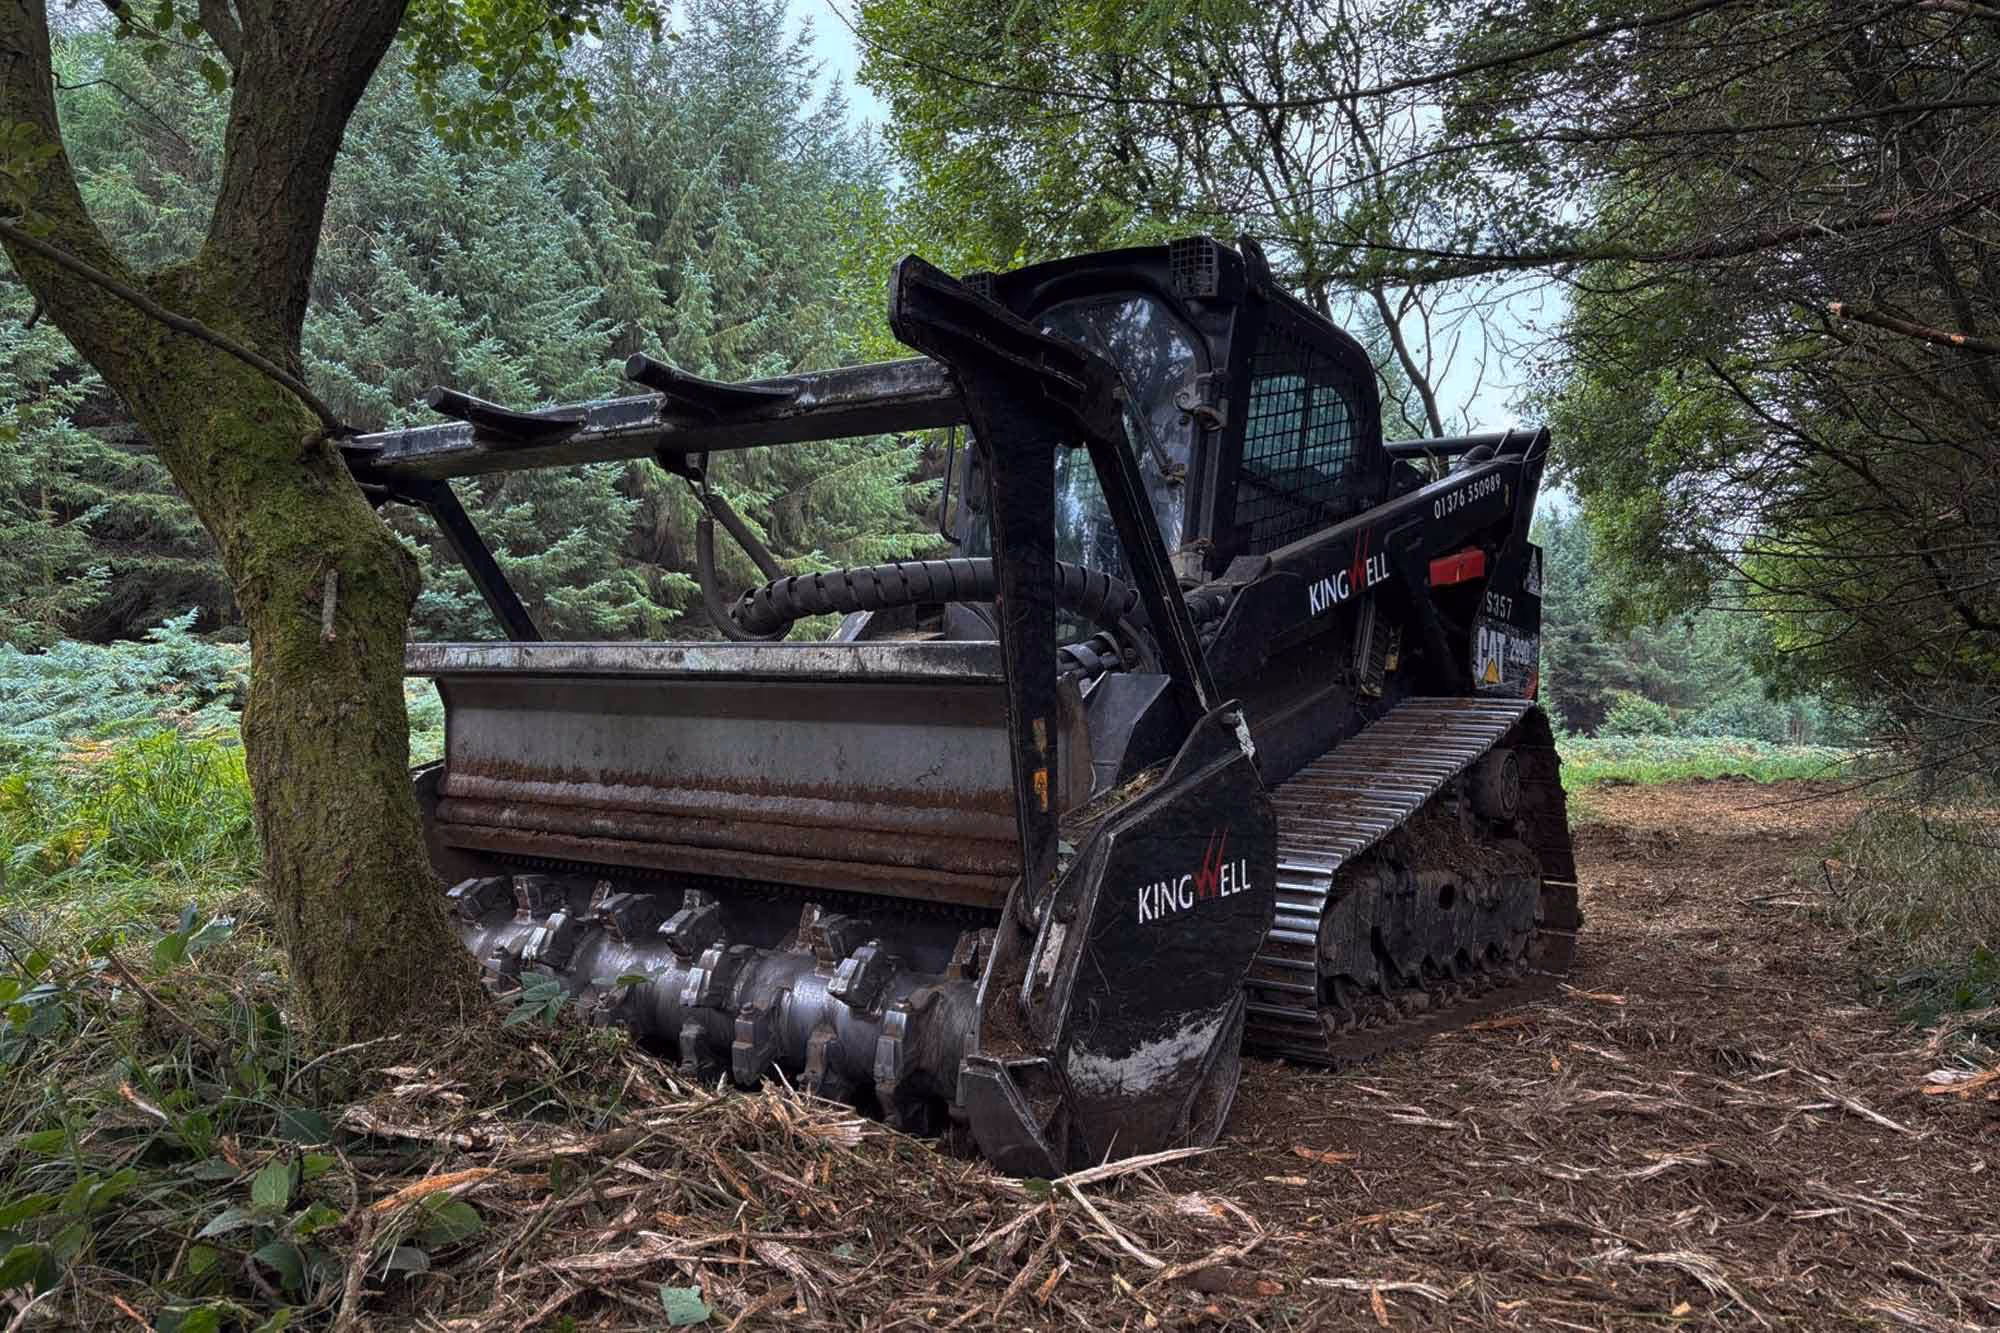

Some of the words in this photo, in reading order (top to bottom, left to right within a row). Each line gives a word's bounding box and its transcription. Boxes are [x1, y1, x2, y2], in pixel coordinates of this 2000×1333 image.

[1434, 488, 1465, 519] 01376
[1468, 472, 1501, 503] 550989
[1308, 527, 1390, 616] KINGWELL
[1486, 591, 1513, 620] S357
[1477, 626, 1506, 685] CAT
[1137, 824, 1251, 924] KINGWELL
